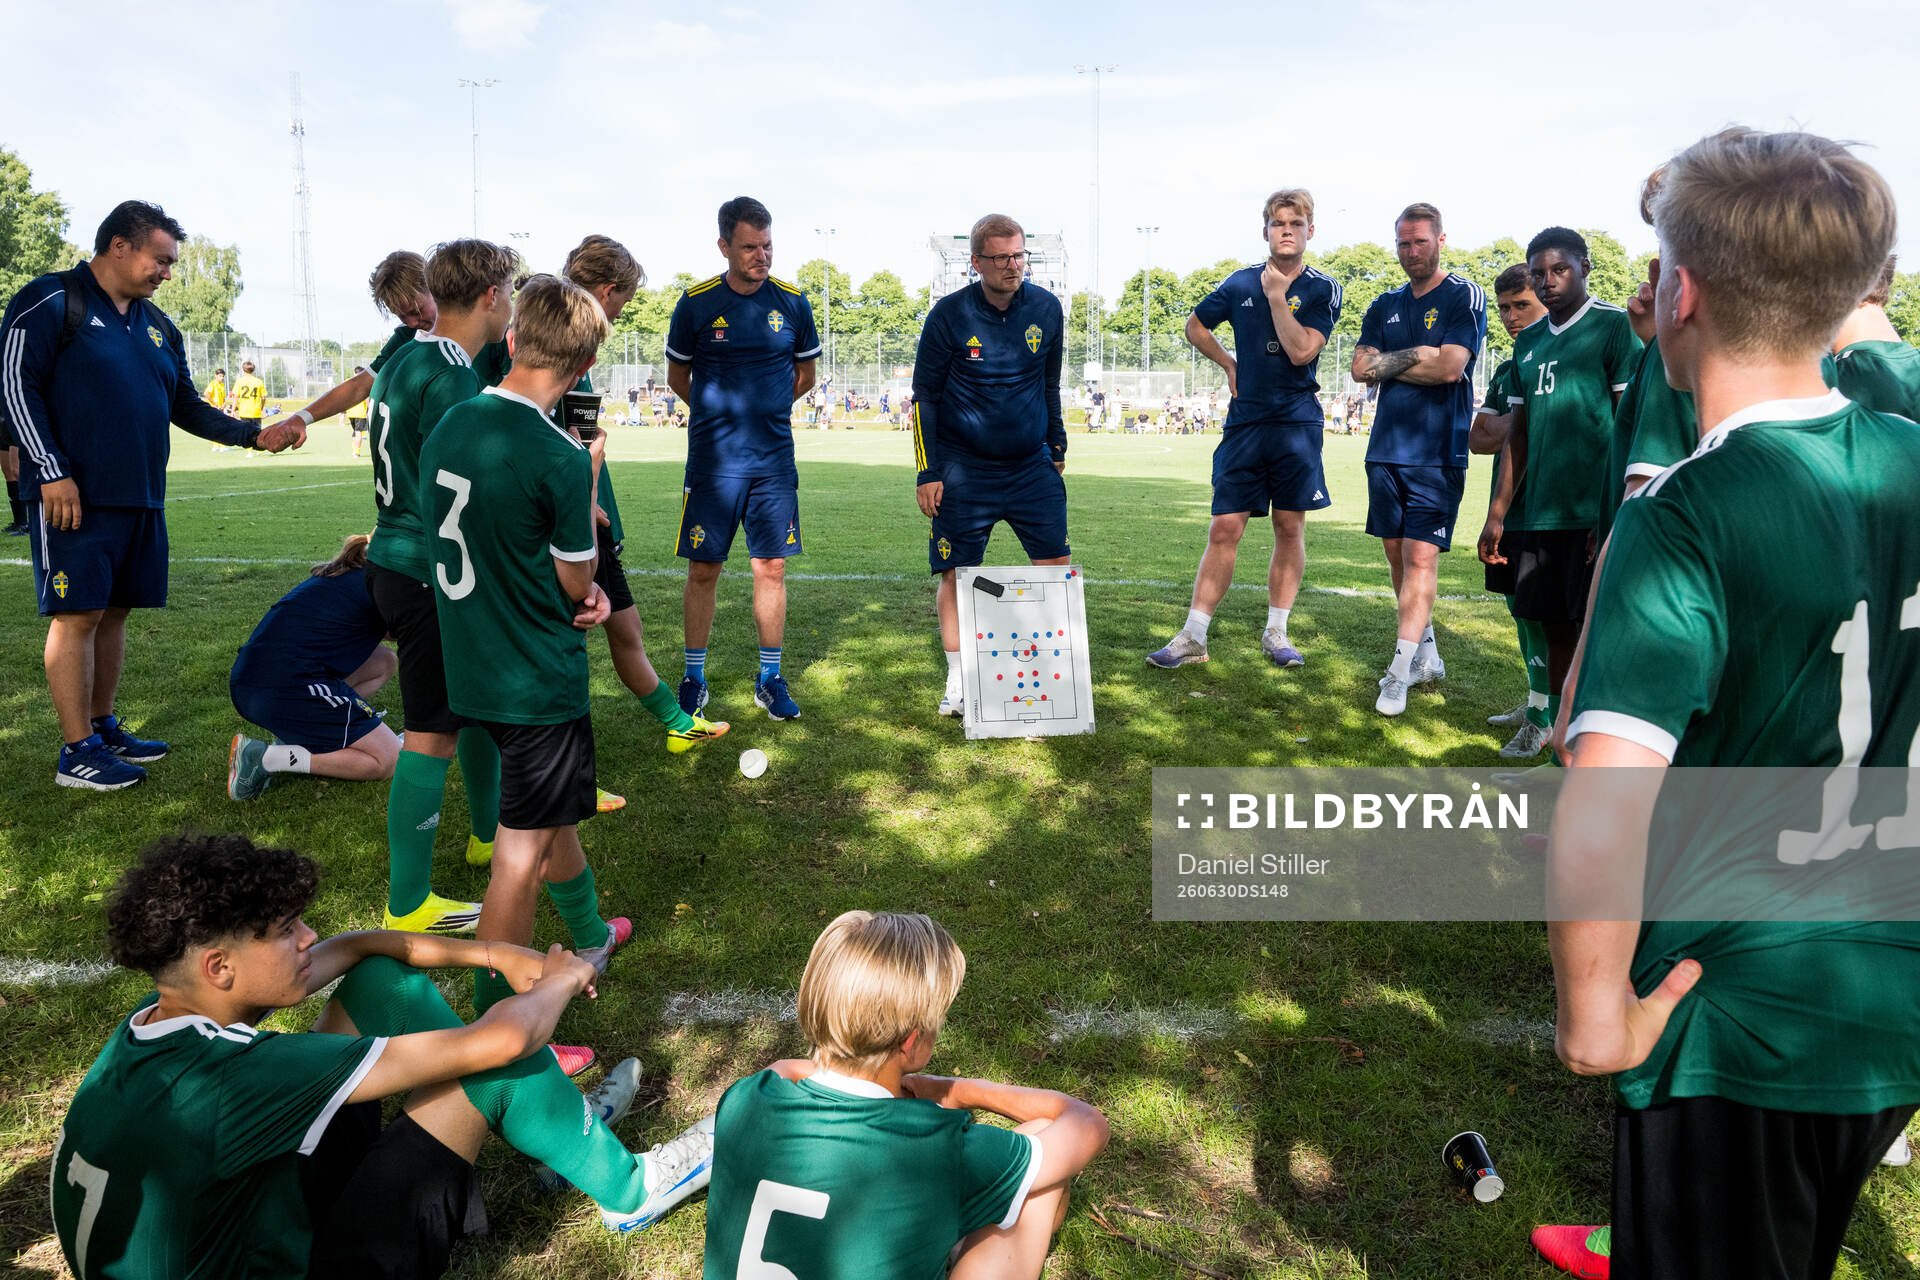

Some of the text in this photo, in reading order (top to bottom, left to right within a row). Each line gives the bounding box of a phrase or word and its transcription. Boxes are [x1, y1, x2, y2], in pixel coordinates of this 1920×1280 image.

[241, 385, 258, 400] 24
[1534, 360, 1558, 396] 15
[435, 468, 476, 601] 3
